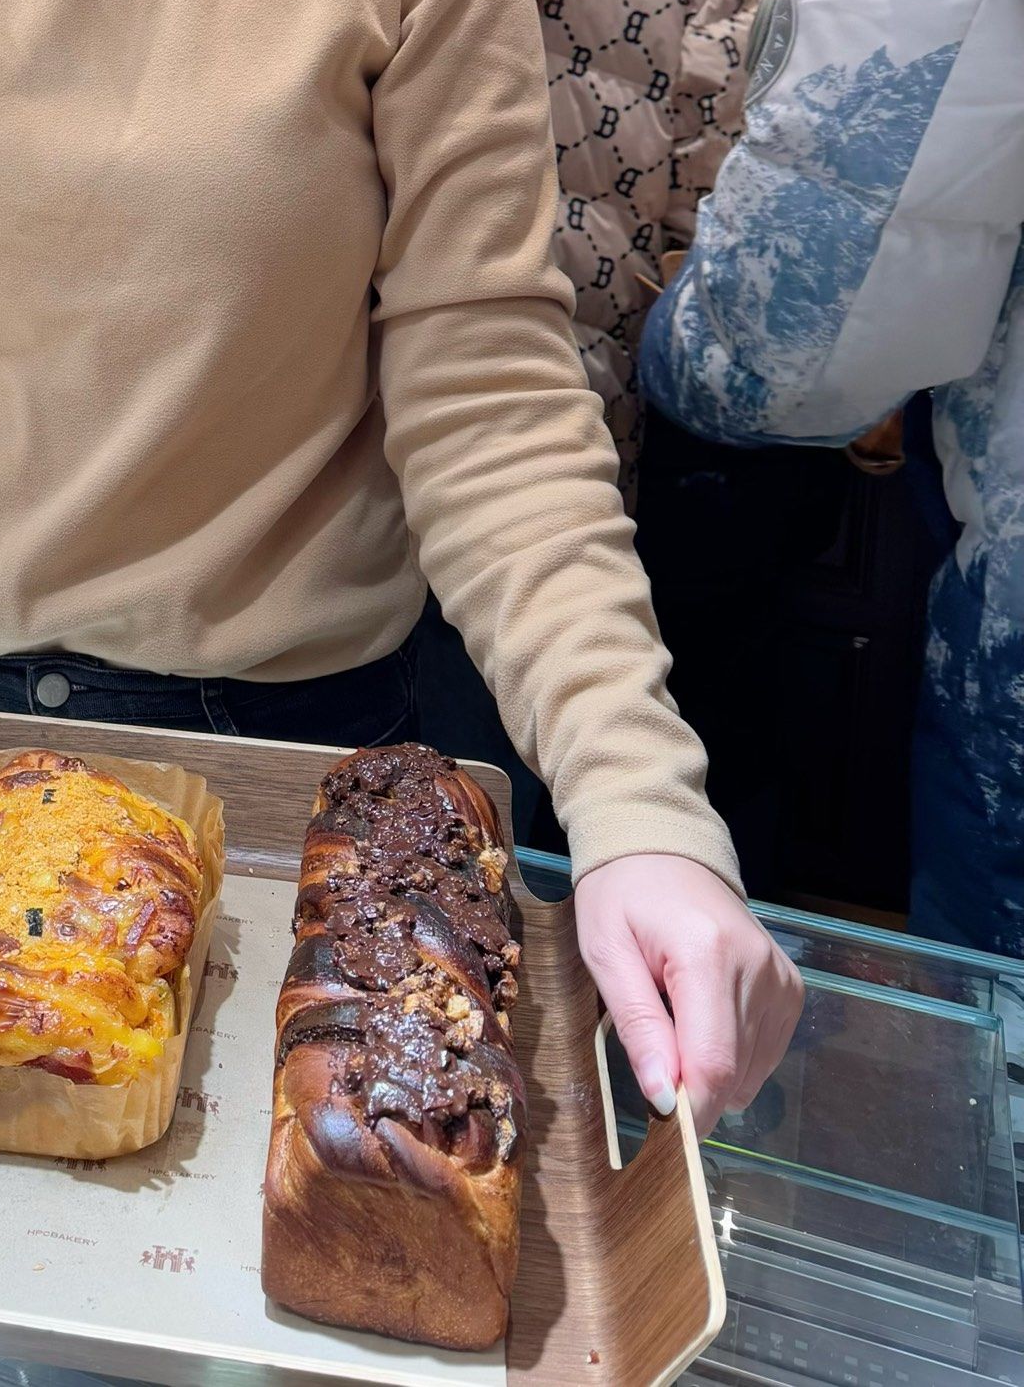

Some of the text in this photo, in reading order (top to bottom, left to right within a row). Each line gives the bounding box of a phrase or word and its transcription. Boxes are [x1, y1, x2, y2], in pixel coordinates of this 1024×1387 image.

[567, 45, 592, 77] B
[645, 69, 670, 102] B
[594, 105, 619, 139] B
[591, 256, 615, 289] B
[147, 1167, 217, 1181] HPCBAKERY
[26, 1228, 99, 1246] HPCBAKERY
